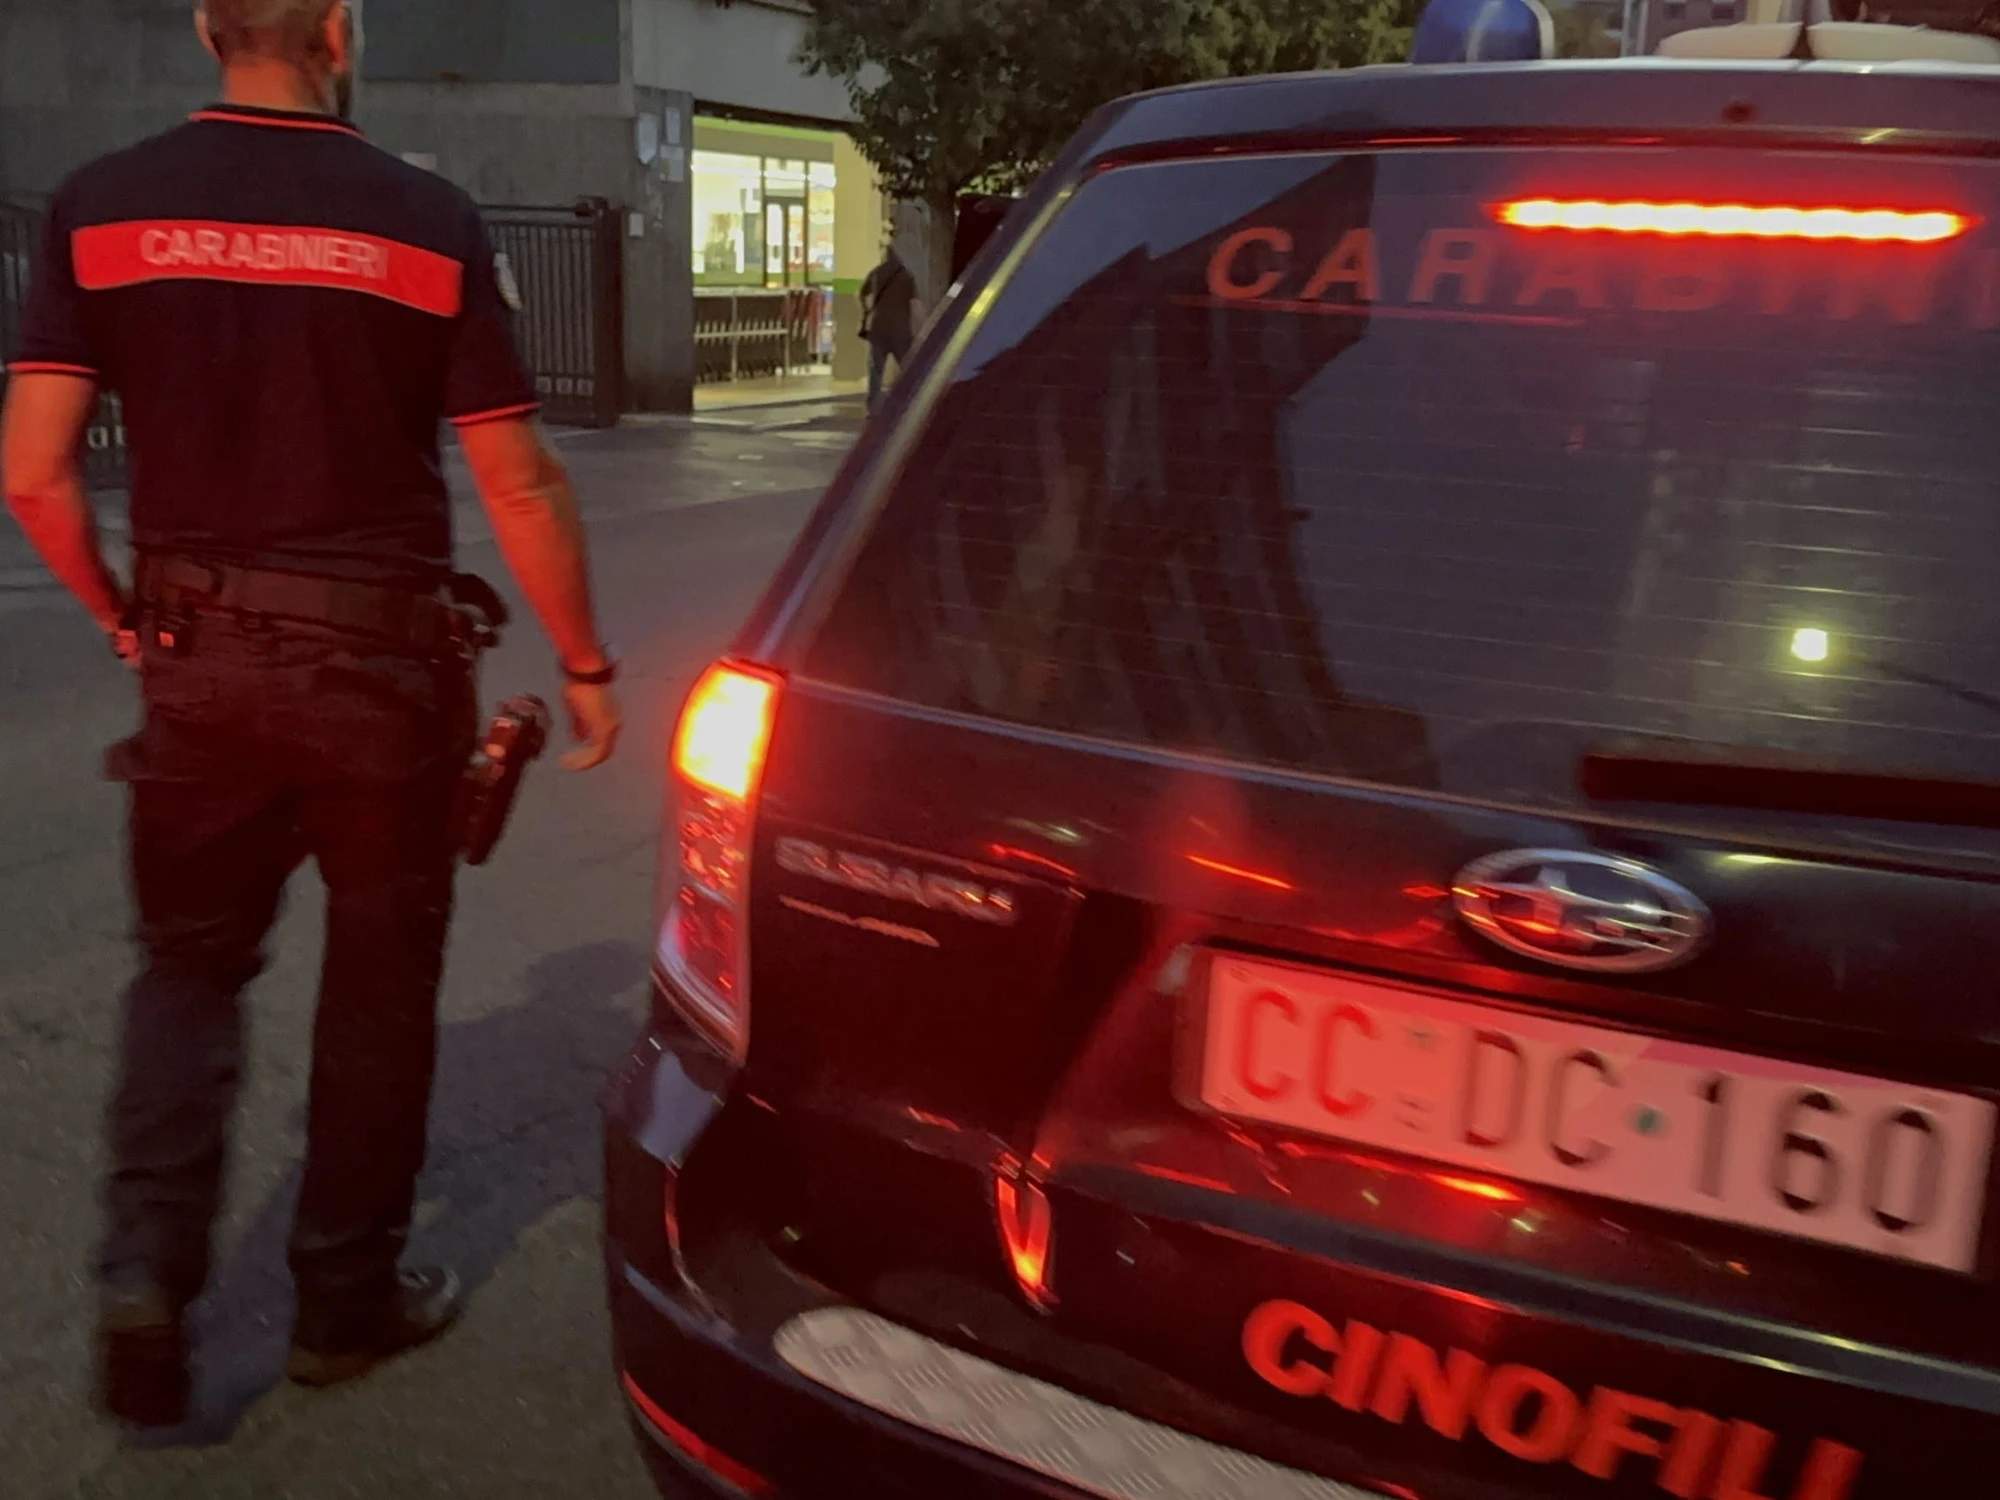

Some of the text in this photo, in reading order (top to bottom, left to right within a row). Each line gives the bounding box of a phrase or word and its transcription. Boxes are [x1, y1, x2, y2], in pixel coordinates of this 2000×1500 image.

[139, 228, 389, 280] CARABINIERI
[1236, 988, 1943, 1233] CC DC 160
[1241, 1299, 1866, 1500] CINOFILI
